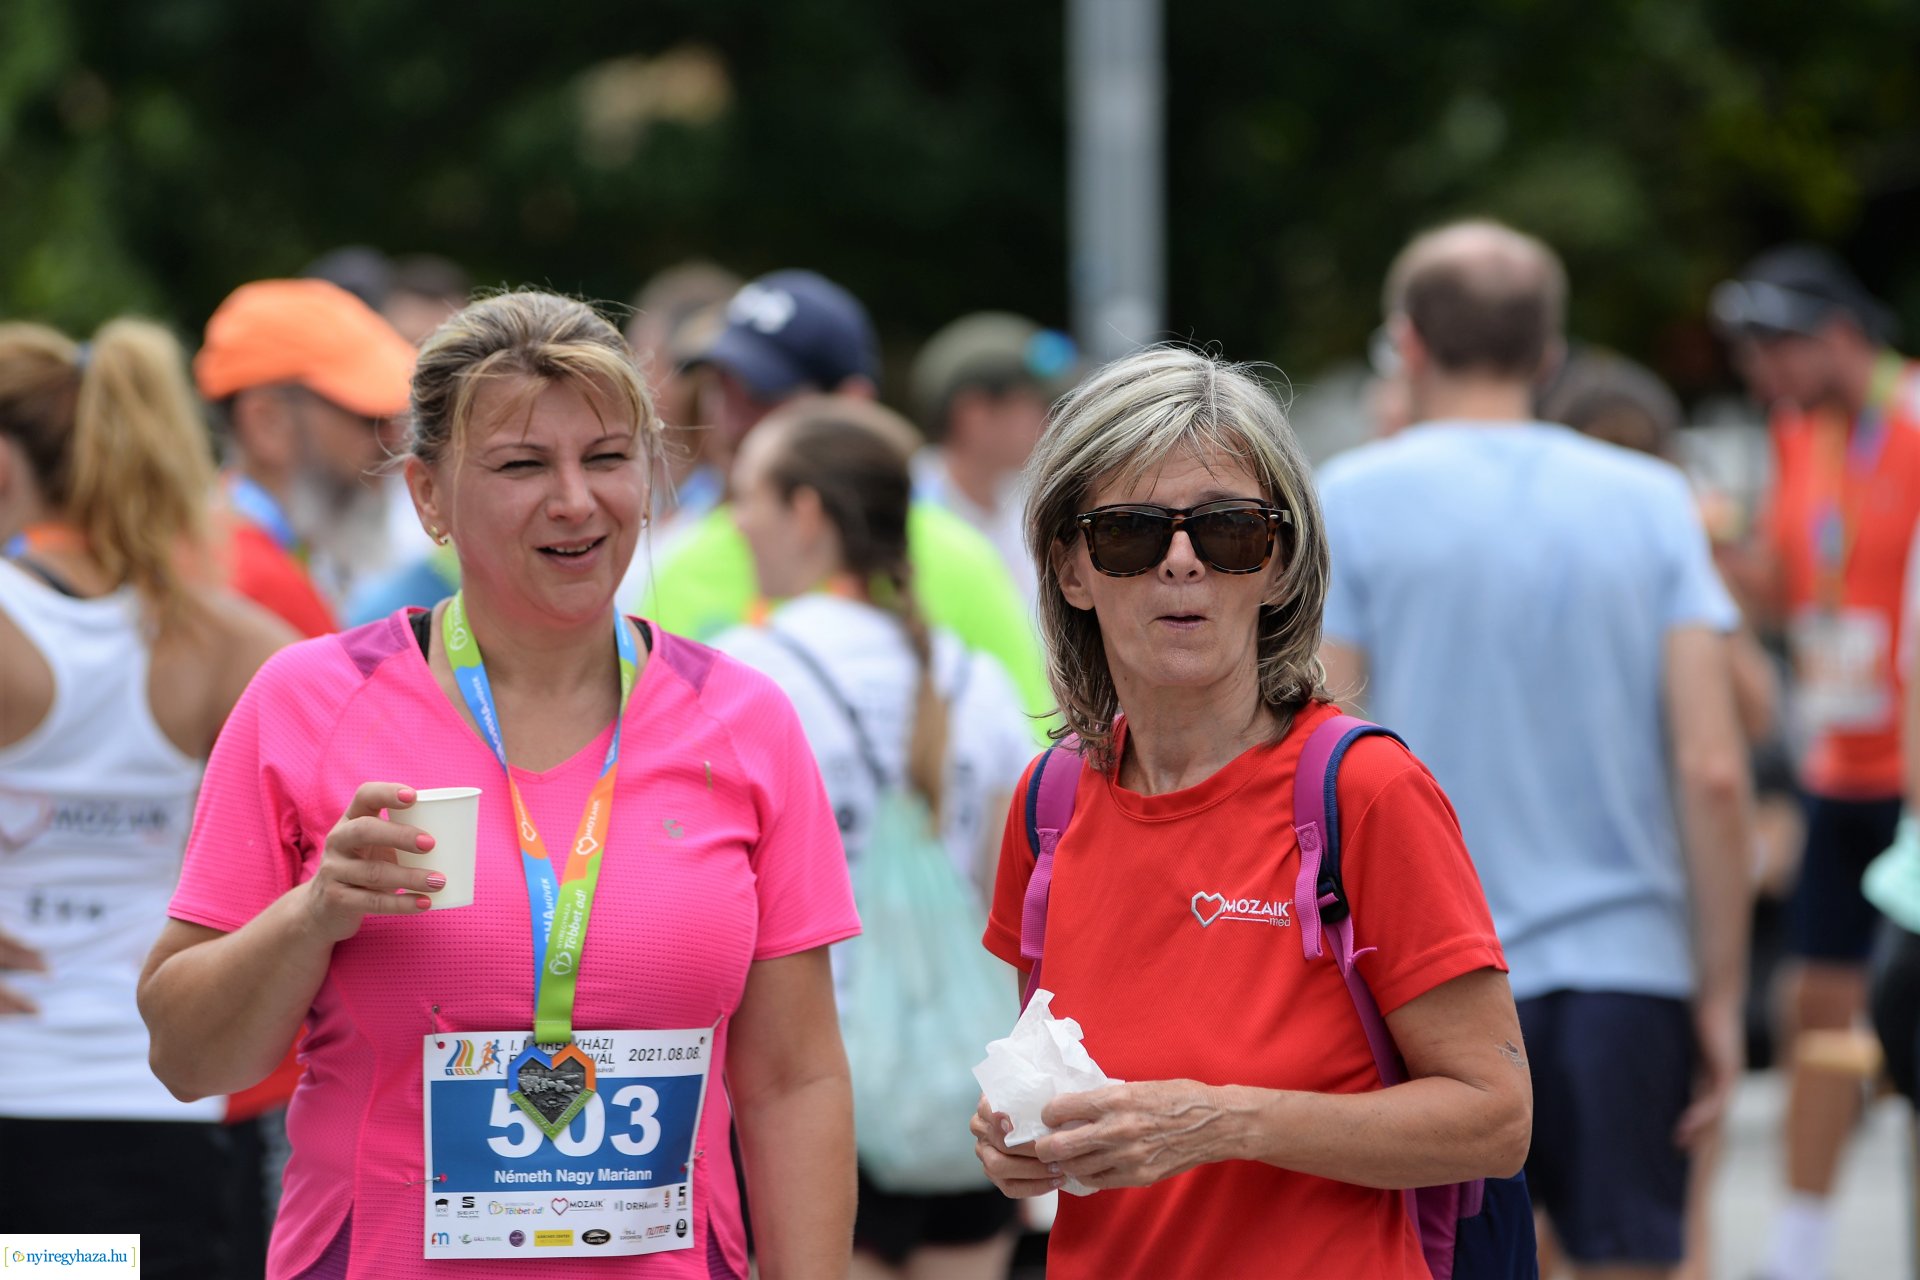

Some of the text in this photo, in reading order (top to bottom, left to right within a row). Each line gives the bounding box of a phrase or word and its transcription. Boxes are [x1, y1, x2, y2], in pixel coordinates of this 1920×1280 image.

[1223, 899, 1289, 917] MOZAIK
[1269, 917, 1291, 927] med
[628, 1046, 701, 1062] 2021.08.08.
[487, 1085, 662, 1158] 503
[494, 1167, 652, 1185] Németh Nagy Mariann
[569, 1200, 604, 1208] MOZAIK
